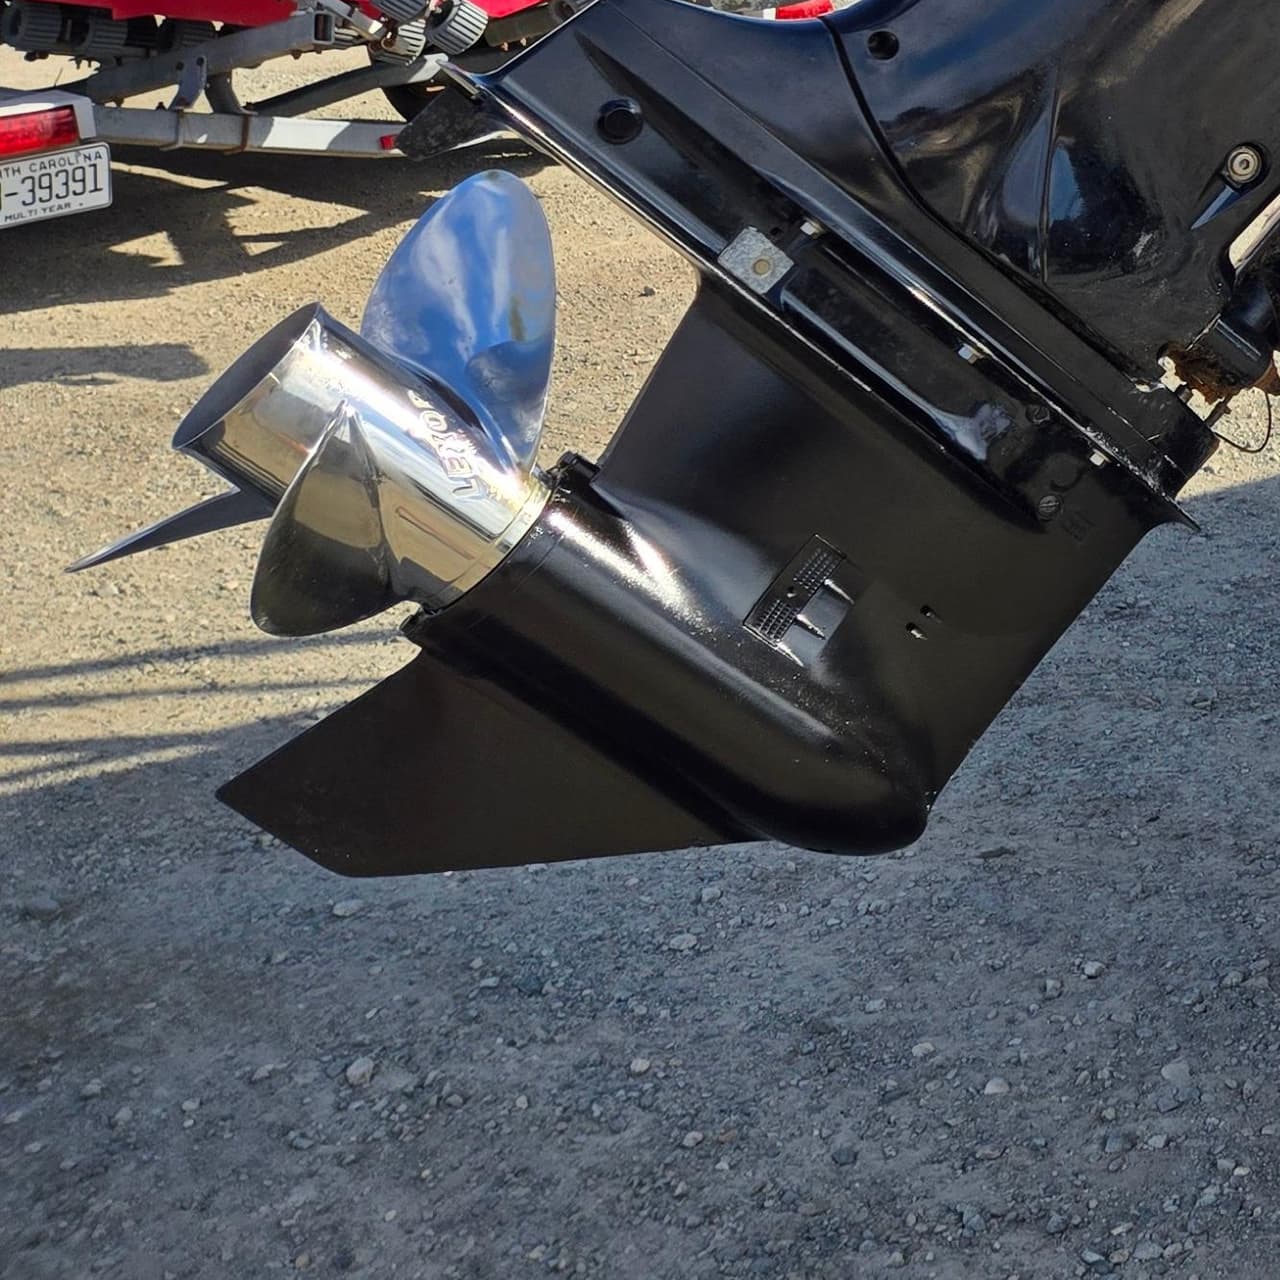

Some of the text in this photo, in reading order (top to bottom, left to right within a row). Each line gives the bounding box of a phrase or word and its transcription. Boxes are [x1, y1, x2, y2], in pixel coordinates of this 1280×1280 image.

[29, 151, 103, 173] CAROLINA
[5, 202, 71, 222] MULTI YEAR
